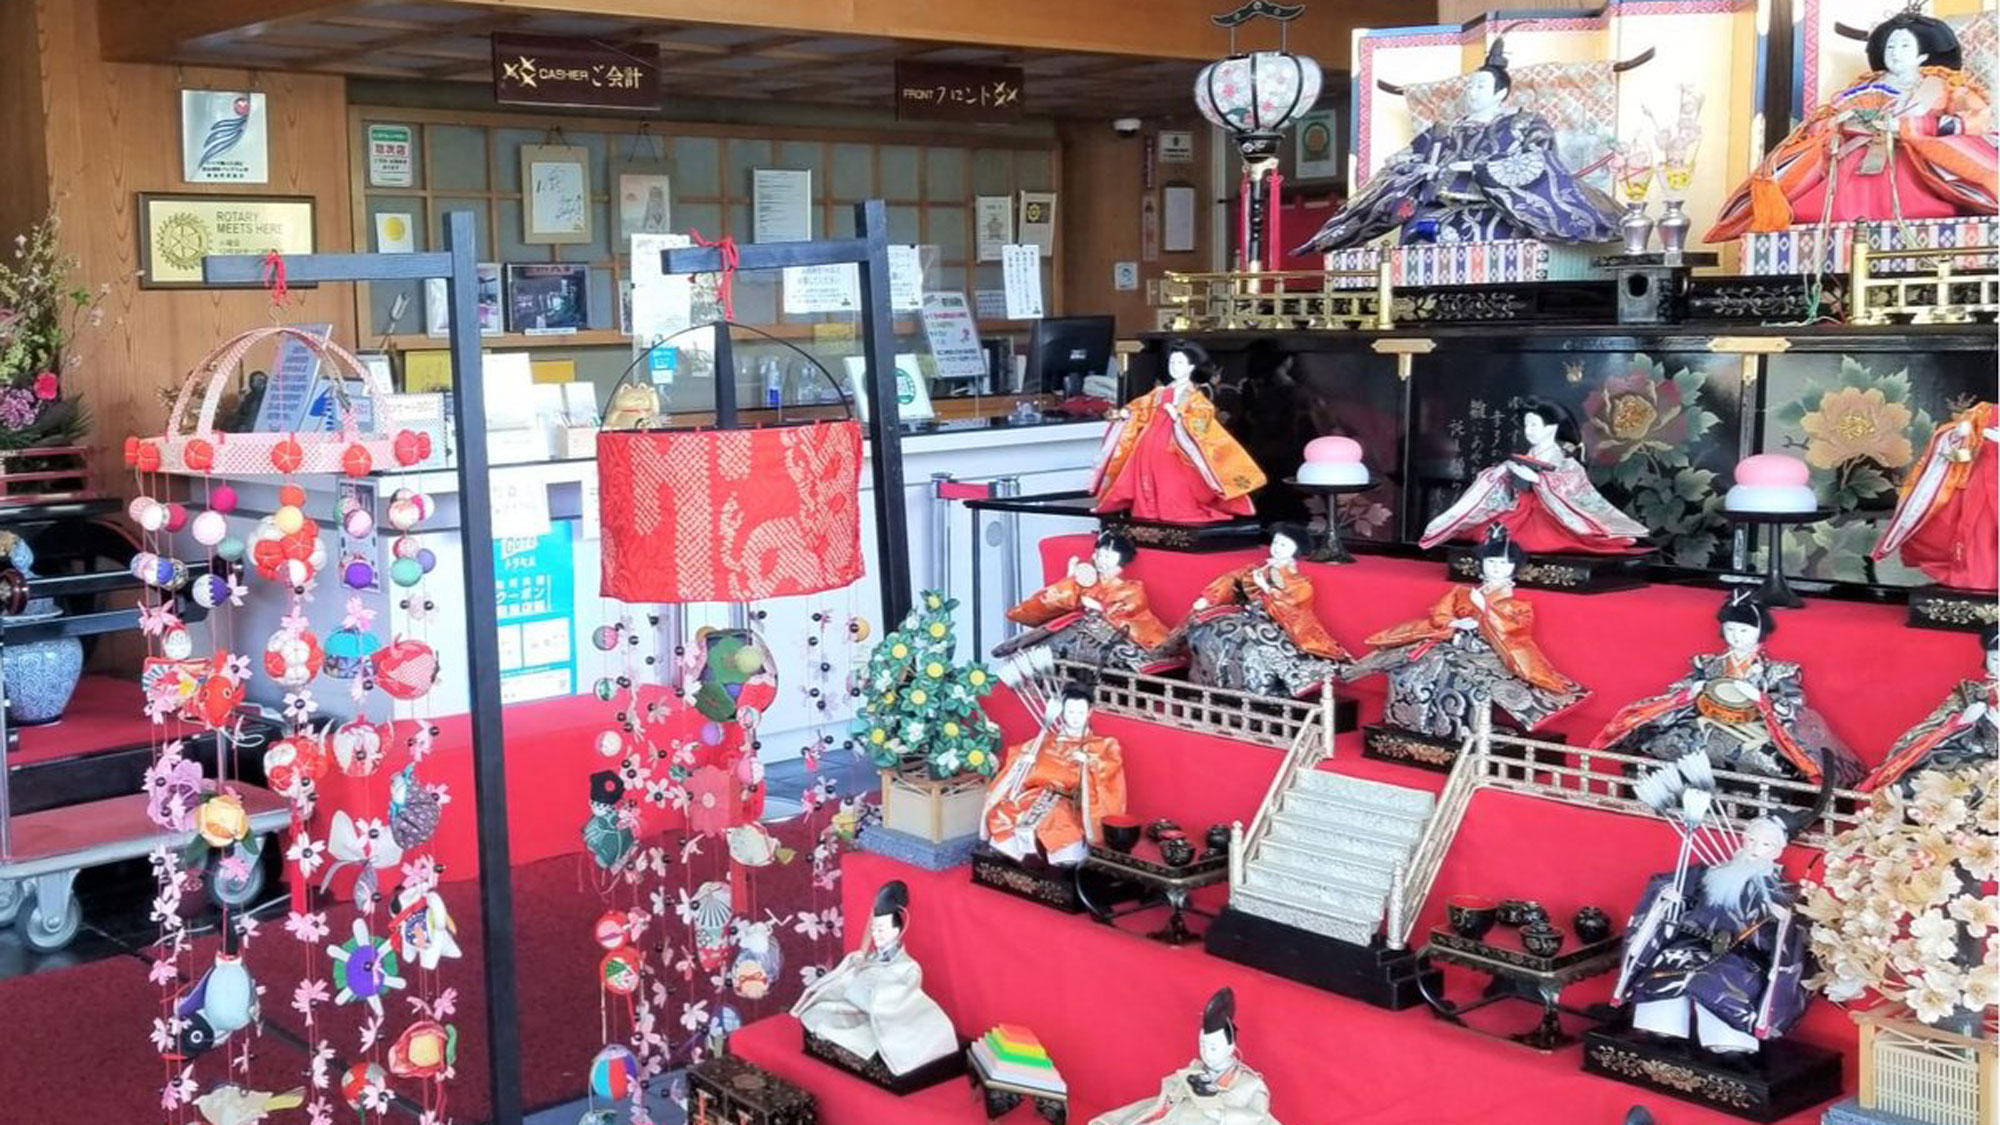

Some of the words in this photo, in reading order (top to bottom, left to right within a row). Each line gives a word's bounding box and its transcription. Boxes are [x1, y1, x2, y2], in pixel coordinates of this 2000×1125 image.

[538, 68, 589, 81] CASHIER
[592, 64, 643, 88] ご会計
[903, 88, 934, 100] FRONT
[936, 85, 991, 107] フロント
[216, 211, 259, 222] ROTARY
[216, 223, 253, 234] MEETS
[255, 223, 284, 234] HERE
